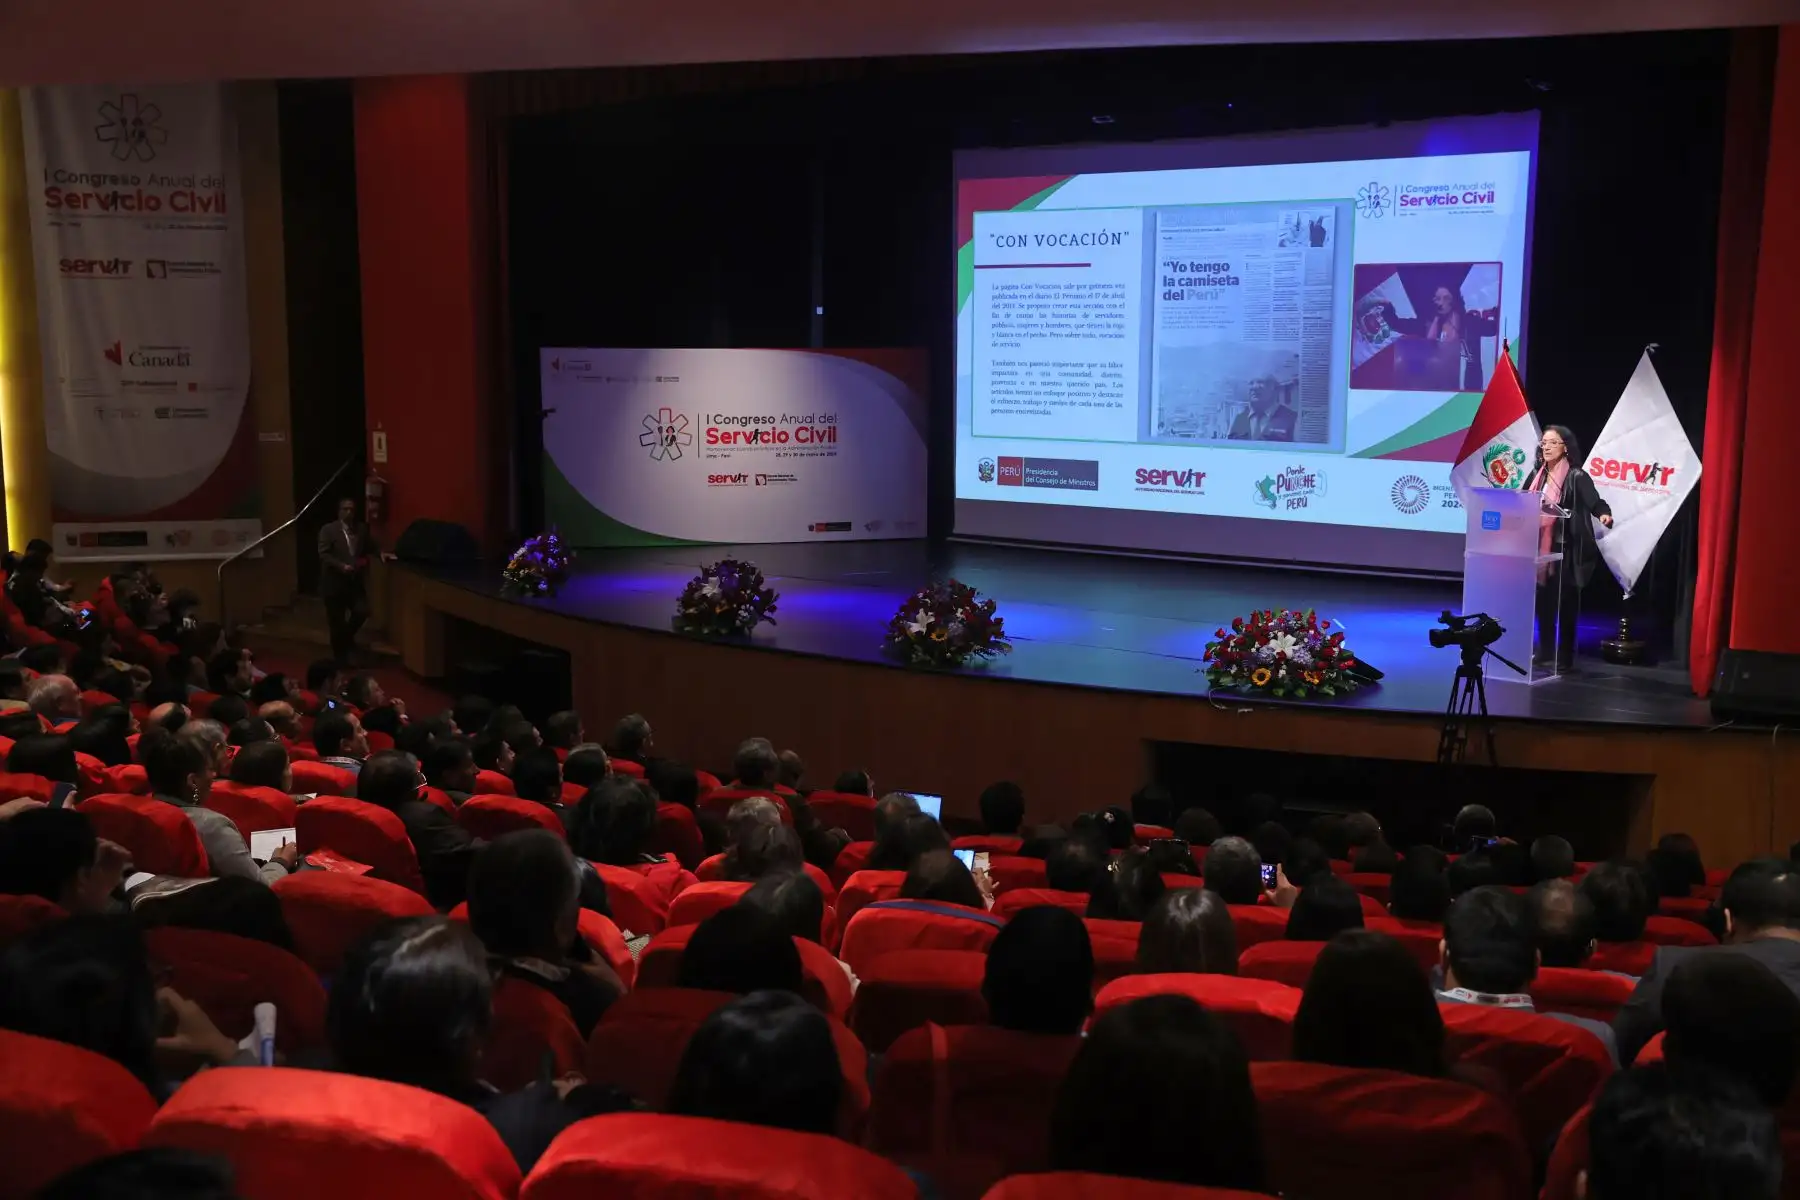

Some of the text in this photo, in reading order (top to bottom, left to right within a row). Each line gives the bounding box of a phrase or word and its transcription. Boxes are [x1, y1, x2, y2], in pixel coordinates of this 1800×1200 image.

[54, 168, 141, 188] Congreso
[147, 173, 196, 188] Anual
[200, 174, 226, 188] del
[1406, 184, 1450, 194] Congreso
[1452, 182, 1478, 191] Anual
[1480, 180, 1496, 190] del
[44, 186, 226, 214] Servicio Civil
[1399, 190, 1495, 207] Servicio Civil
[1190, 262, 1230, 274] tengo
[1162, 274, 1240, 287] la camiseta
[1162, 289, 1184, 301] del
[713, 414, 776, 427] Congreso
[780, 412, 816, 424] Anual
[818, 412, 838, 424] del
[706, 426, 837, 445] Servicio Civil
[1000, 464, 1058, 476] PERÚ Presidencia
[1286, 464, 1305, 477] Ponle
[1589, 457, 1675, 486] servir
[708, 472, 749, 484] servir
[1036, 476, 1058, 485] Consejo
[1068, 478, 1096, 486] Ministros
[1135, 468, 1206, 488] servir
[1276, 473, 1316, 494] PUNCHE
[1286, 496, 1307, 510] PERÚ
